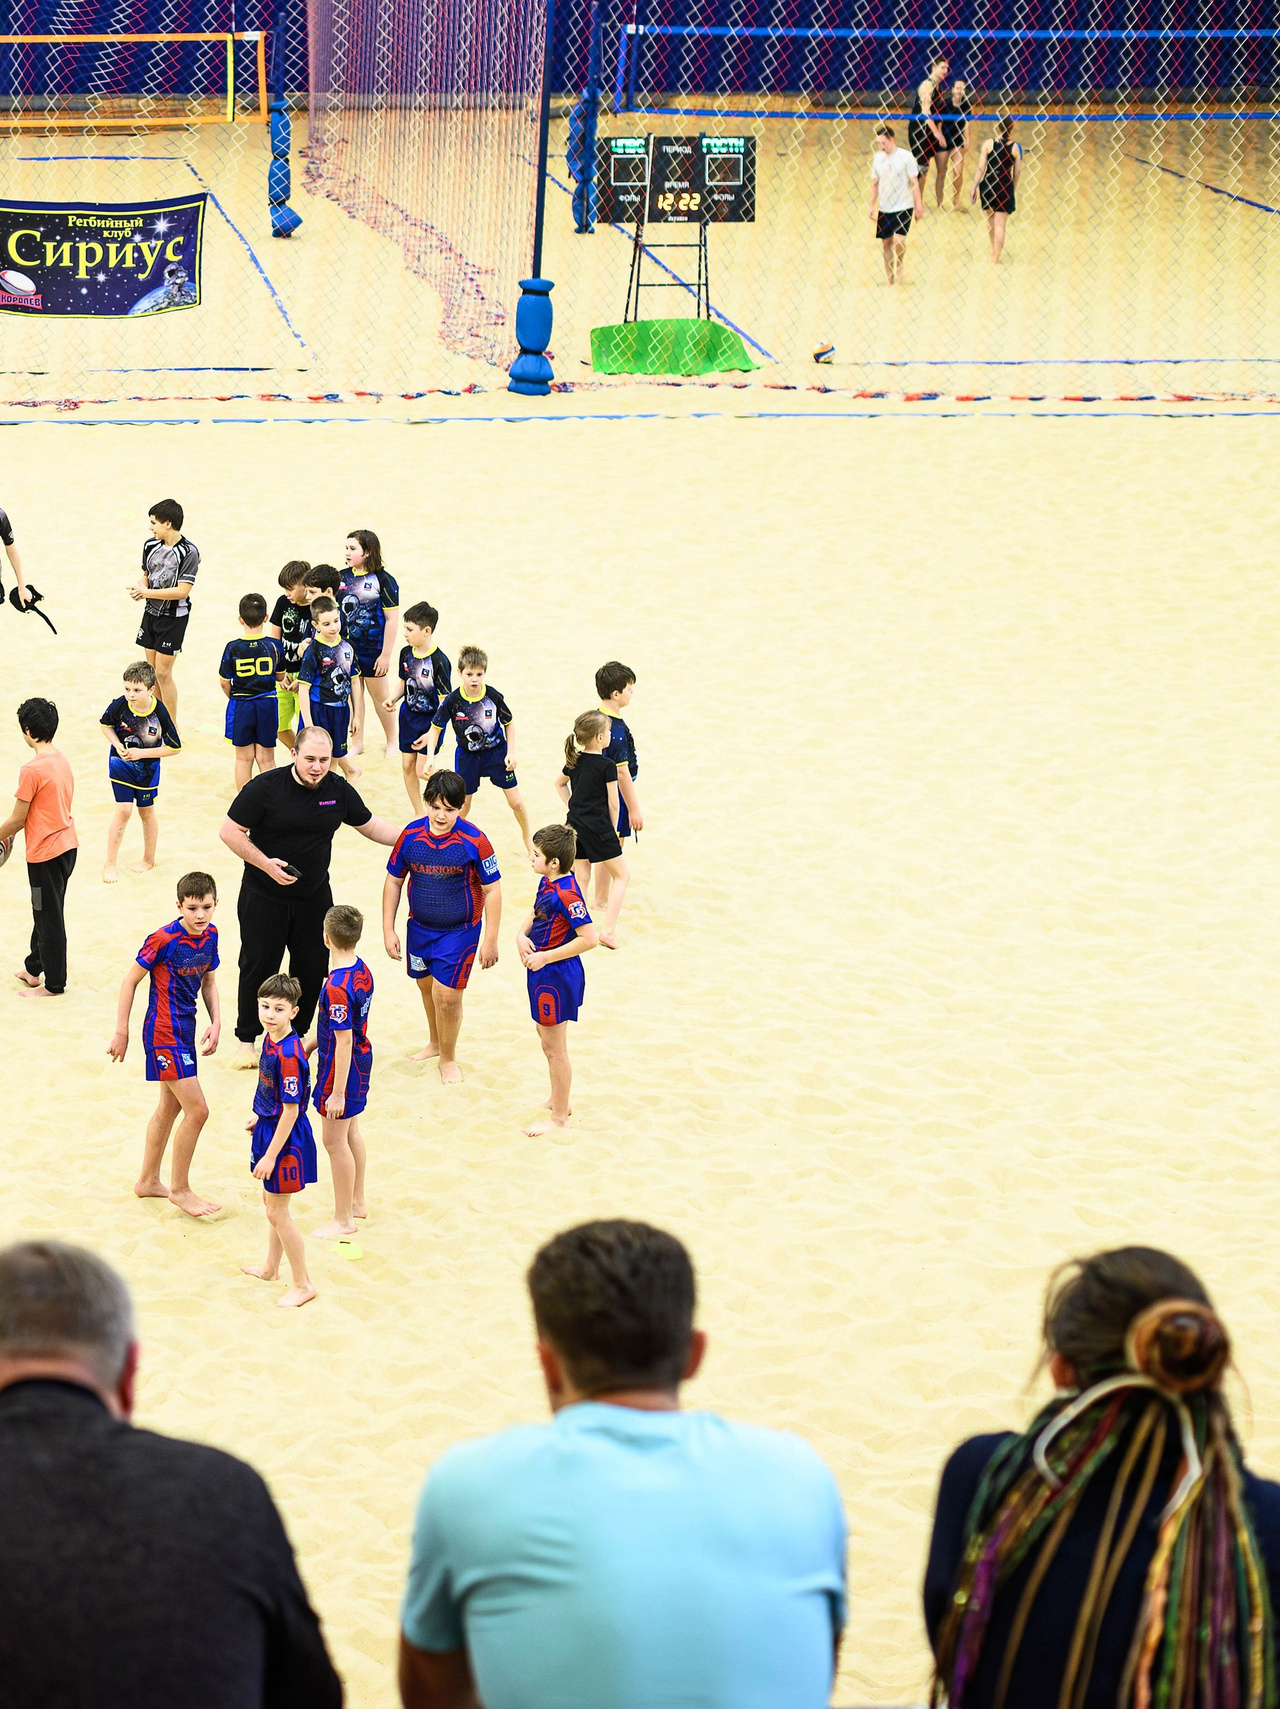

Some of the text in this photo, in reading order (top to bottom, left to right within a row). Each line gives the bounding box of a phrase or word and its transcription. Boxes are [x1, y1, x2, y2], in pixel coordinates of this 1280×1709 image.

[67, 215, 144, 228] Регбийный
[102, 228, 133, 240] клуб
[7, 229, 184, 281] Сириус
[0, 293, 41, 308] КОРОЛЕВ
[235, 656, 273, 678] 50
[543, 1003, 551, 1017] 9
[282, 1166, 297, 1182] 10
